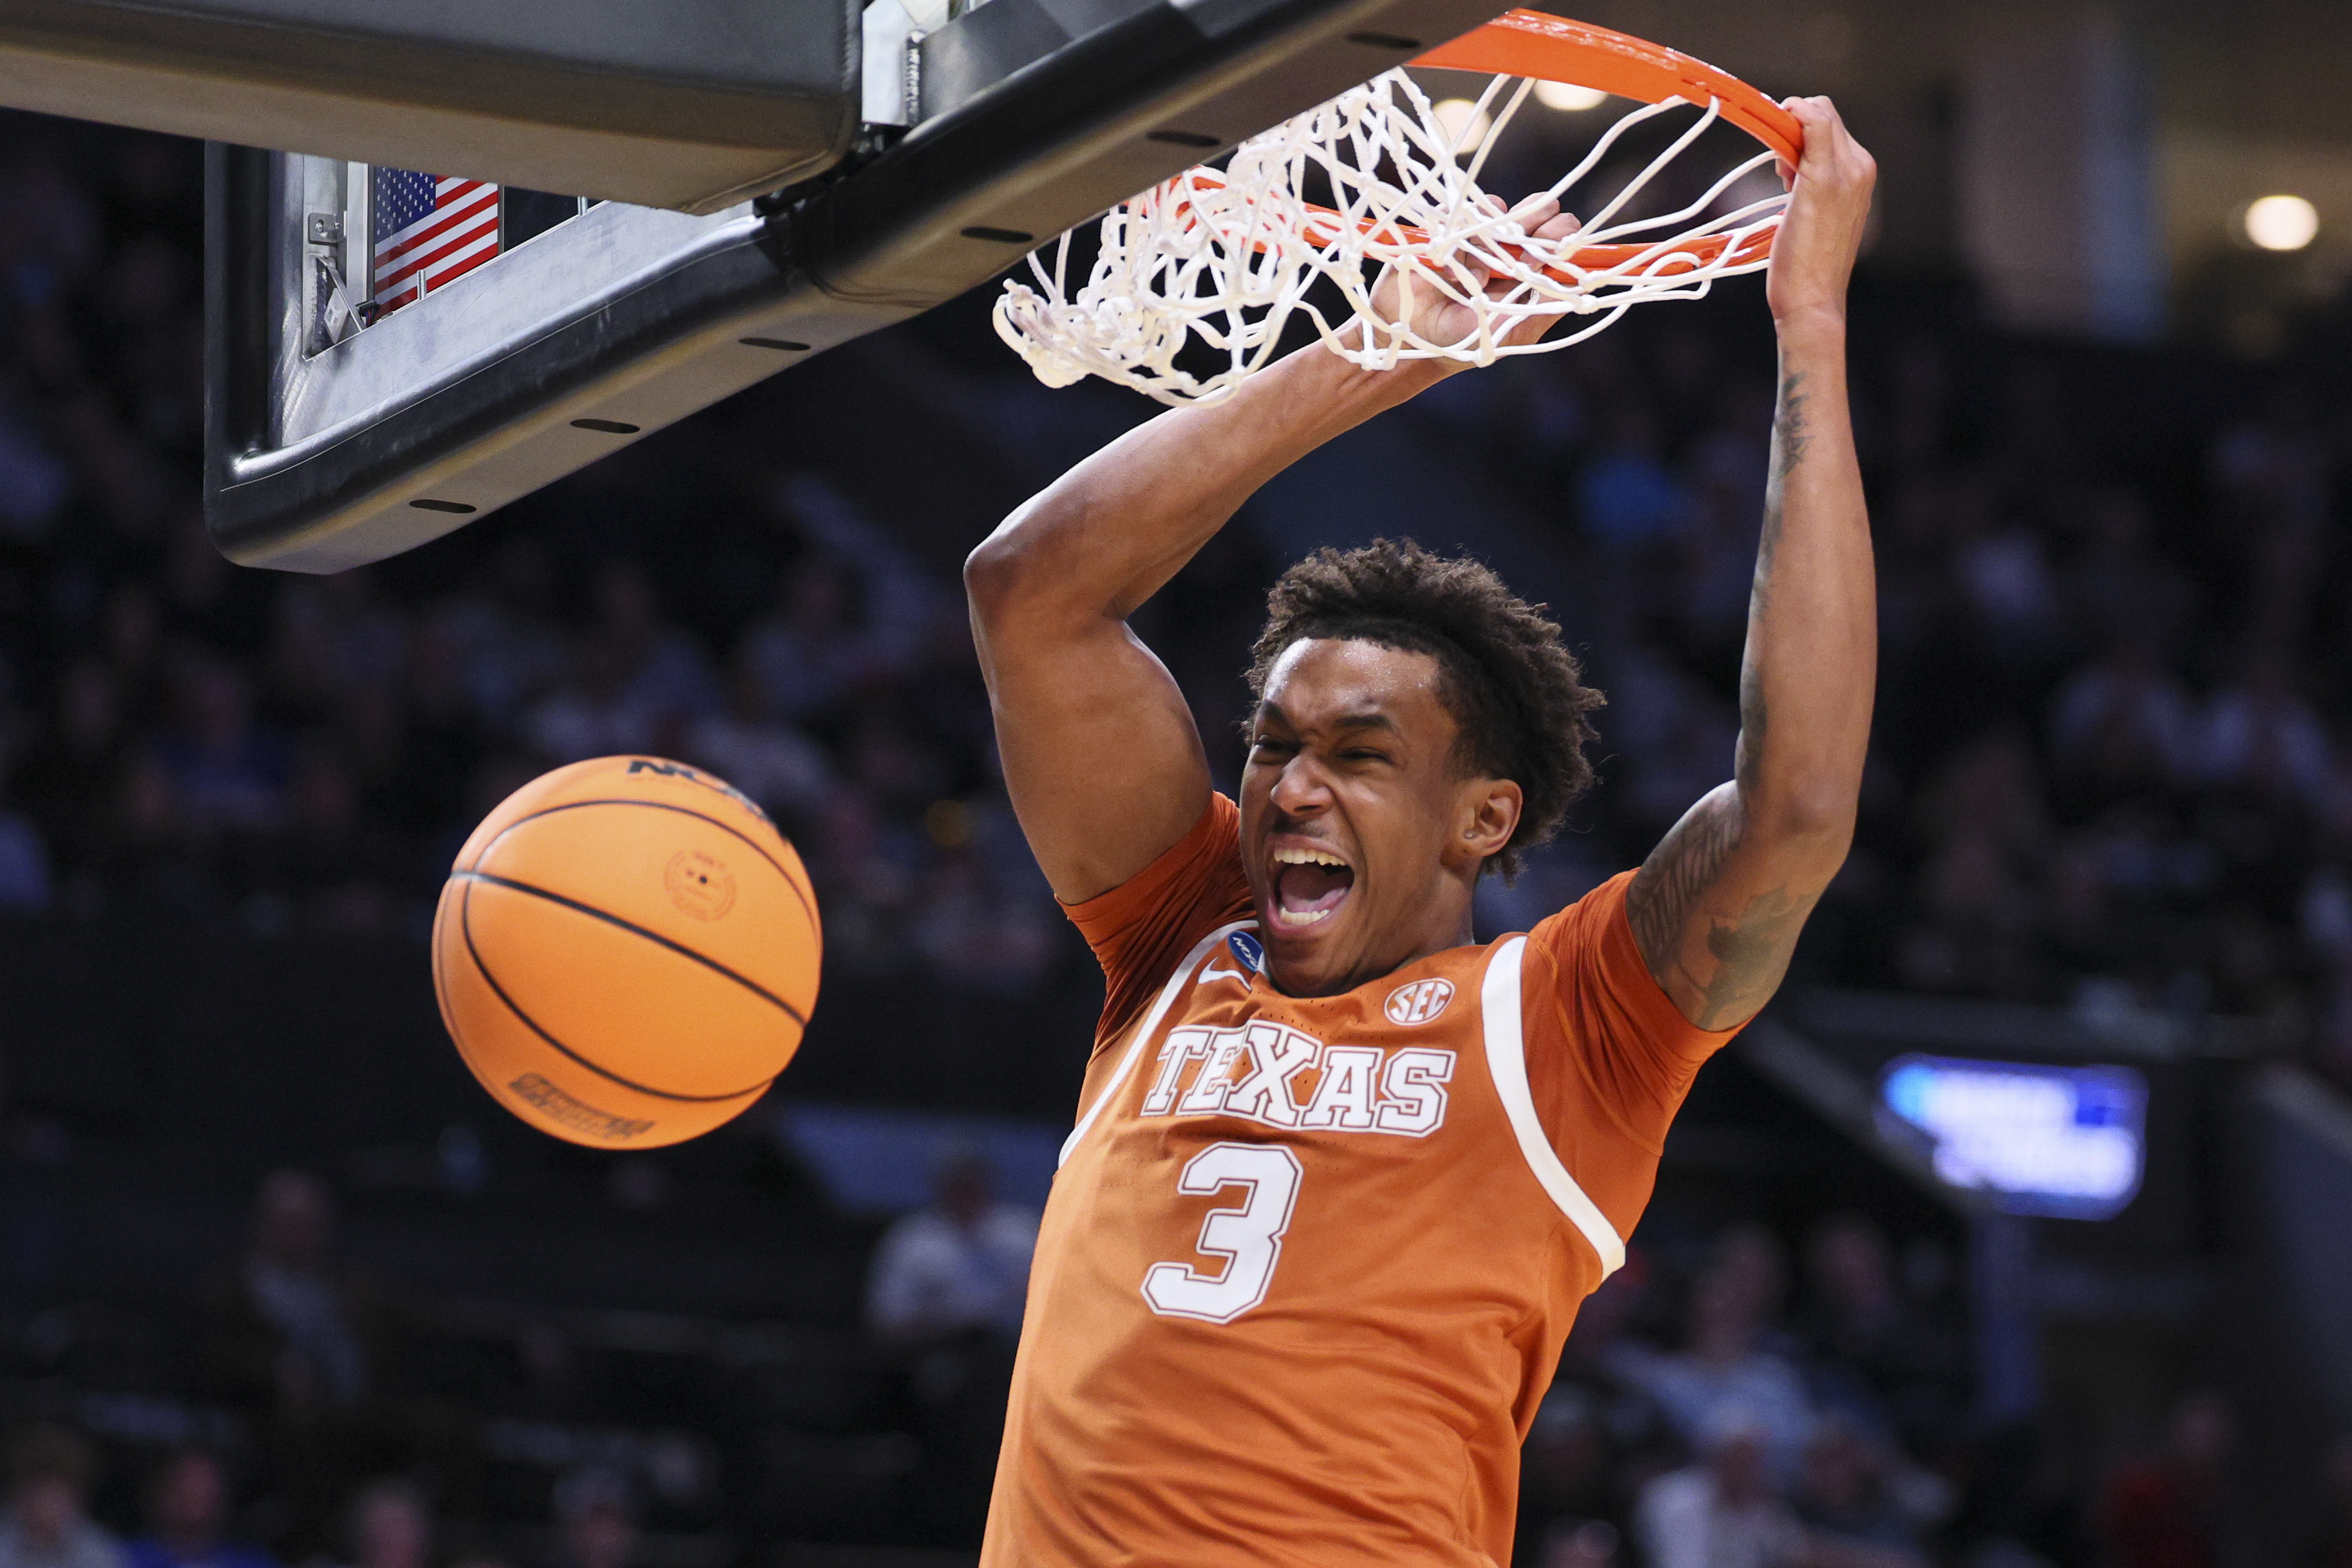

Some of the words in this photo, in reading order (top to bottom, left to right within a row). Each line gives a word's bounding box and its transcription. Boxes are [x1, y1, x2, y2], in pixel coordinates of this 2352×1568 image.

[1390, 981, 1450, 1023] SEC
[1140, 1019, 1457, 1138] TEXAS
[1139, 1141, 1304, 1325] 3
